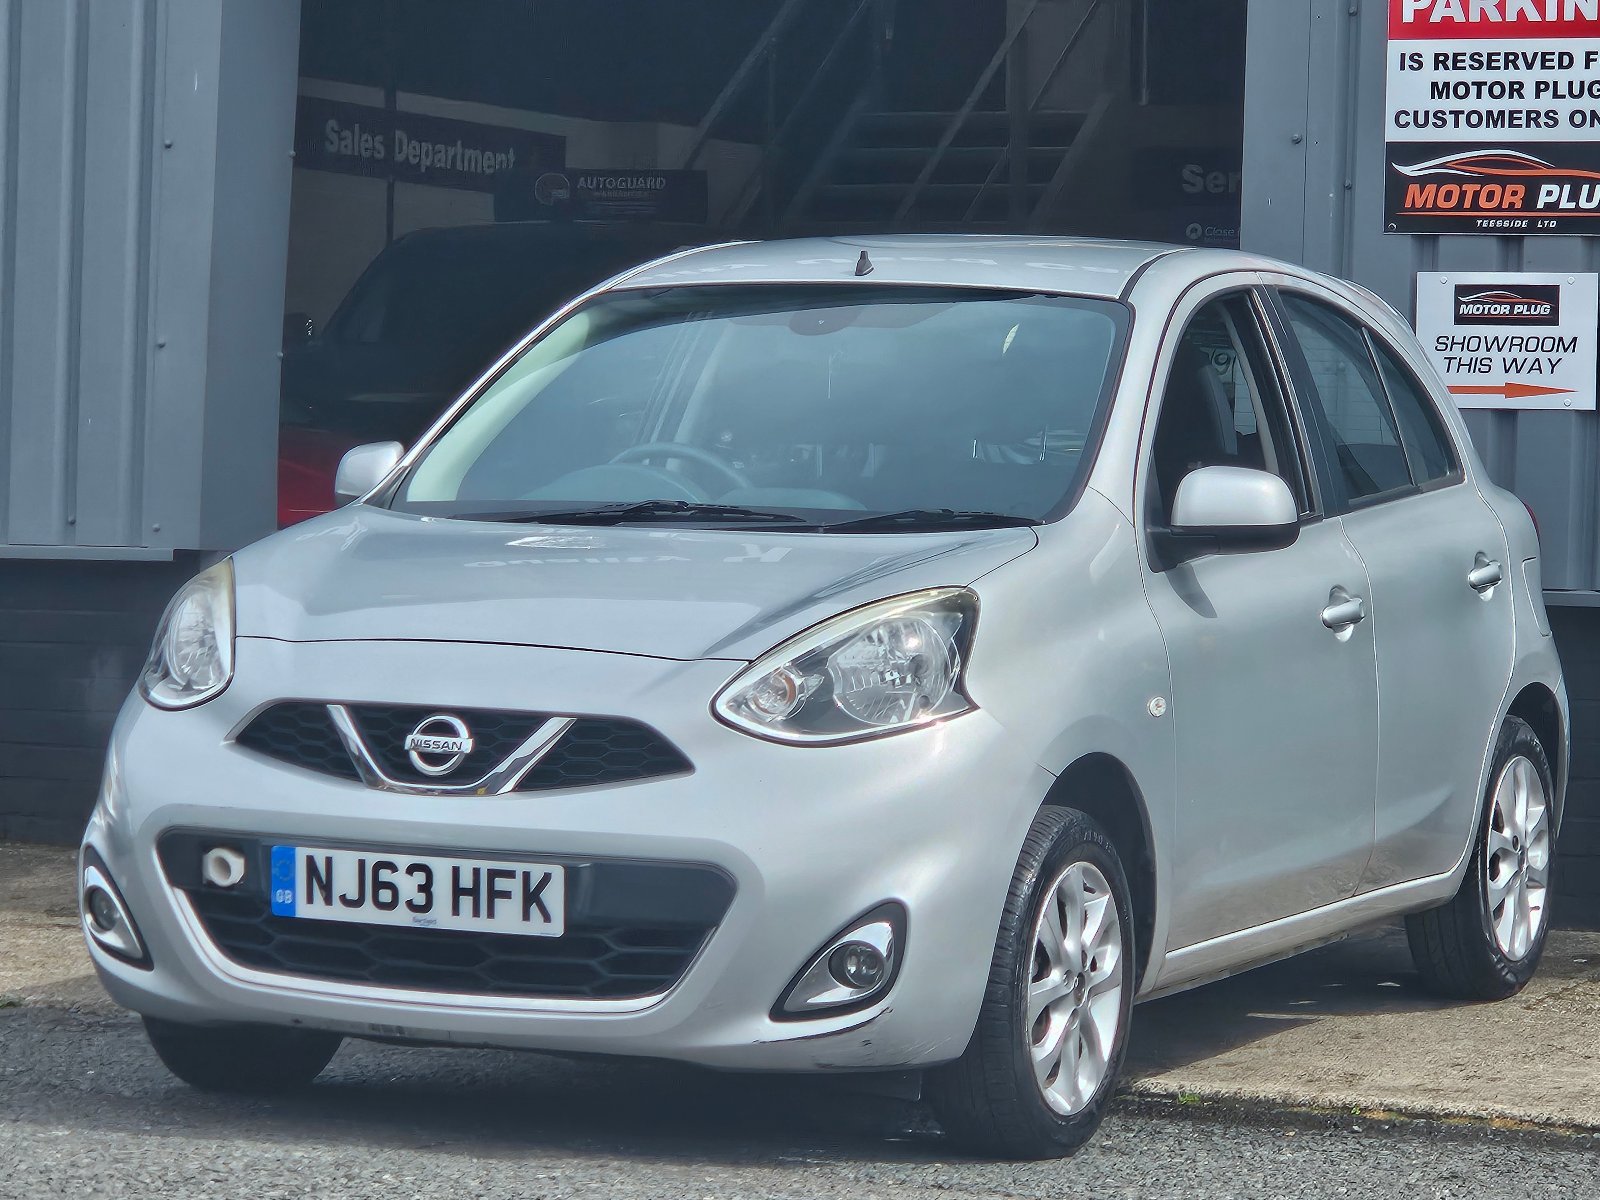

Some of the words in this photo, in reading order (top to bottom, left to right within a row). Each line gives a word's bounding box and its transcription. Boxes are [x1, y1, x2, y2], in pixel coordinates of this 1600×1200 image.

[1399, 52, 1424, 71] IS
[1433, 51, 1574, 71] RESERVED
[1430, 80, 1525, 100] MOTOR
[1535, 79, 1600, 100] PLUG
[1394, 109, 1559, 129] CUSTOMERS
[325, 118, 385, 160] Sales
[393, 129, 516, 174] Department
[577, 176, 667, 190] AUTOGUARD
[1404, 183, 1526, 209] MOTOR
[1205, 226, 1235, 237] Close
[1476, 219, 1528, 228] TEESSIDE
[1537, 219, 1557, 228] LTD
[1459, 304, 1511, 315] MOTOR
[1513, 304, 1551, 315] PLUG
[1434, 335, 1578, 353] SHOWROOM
[1444, 356, 1493, 373] THIS
[1502, 357, 1563, 374] WAY
[409, 738, 463, 751] NISSAN
[275, 889, 293, 904] GB
[305, 855, 434, 914] NJ63
[451, 865, 552, 924] HFK
